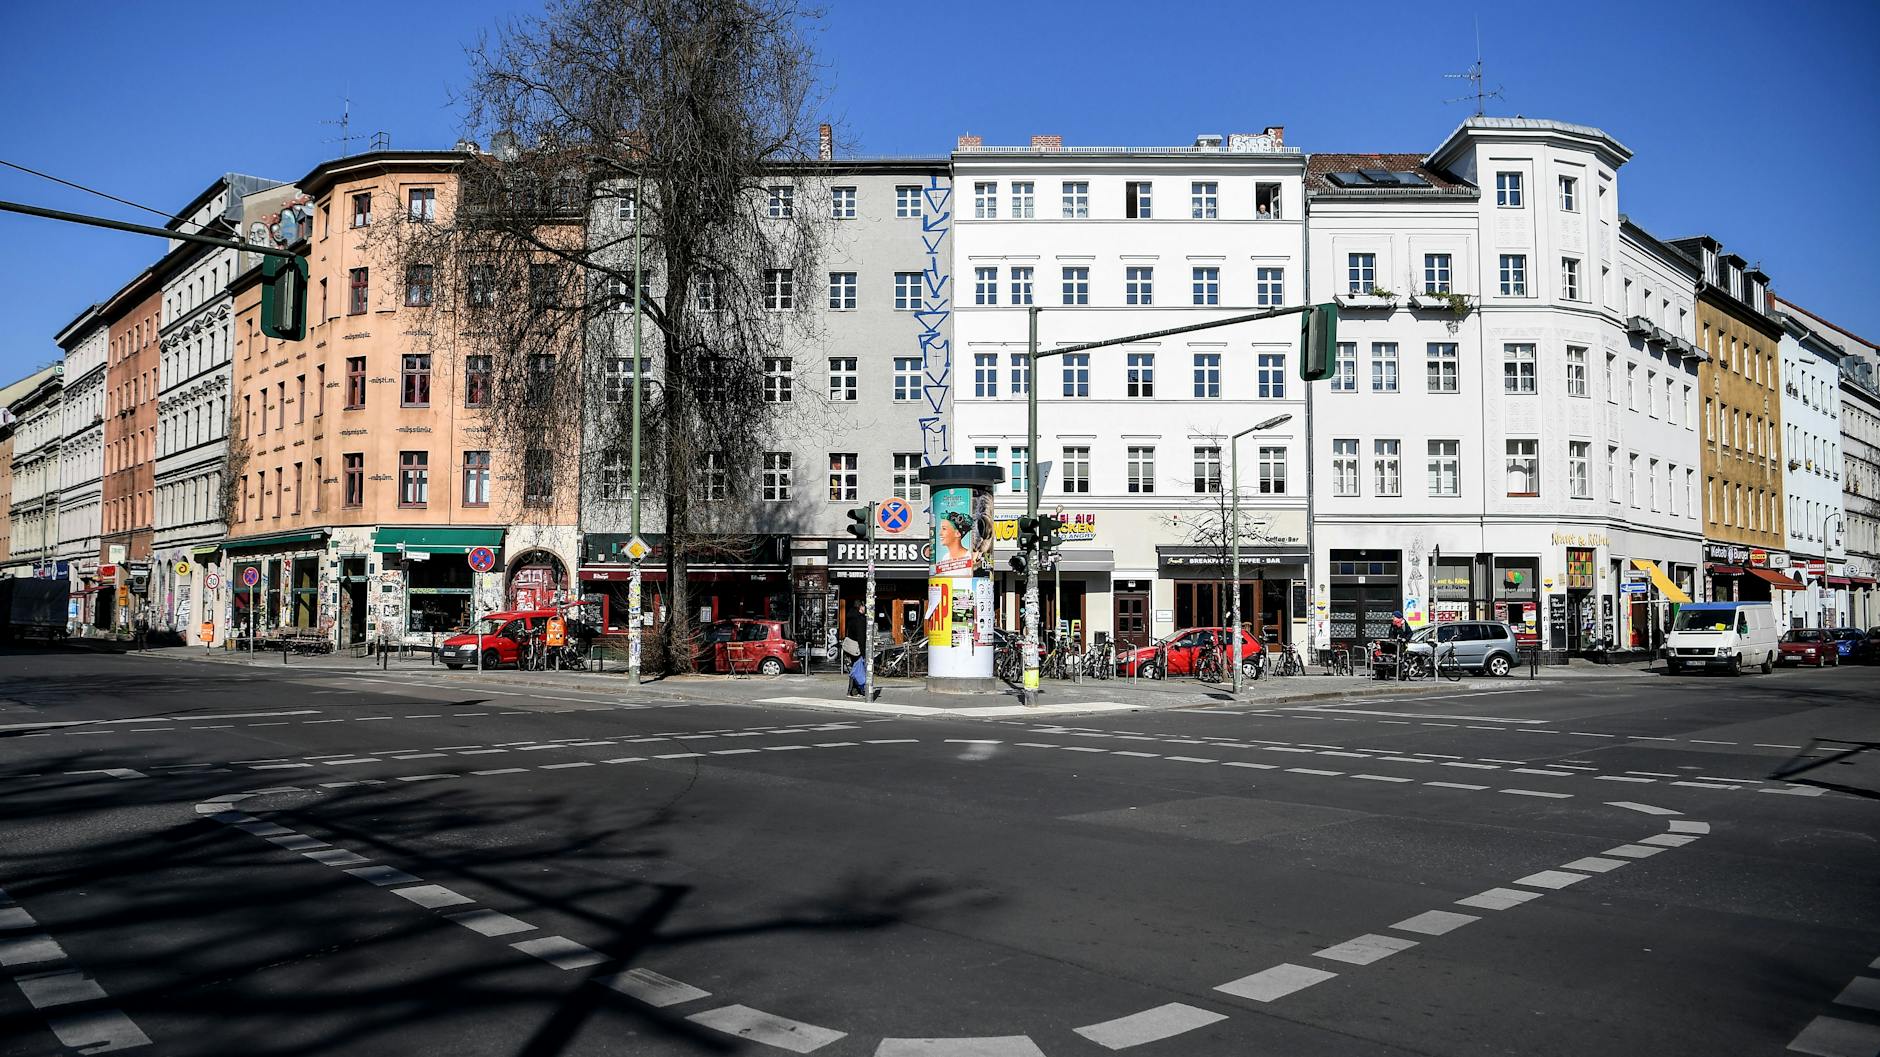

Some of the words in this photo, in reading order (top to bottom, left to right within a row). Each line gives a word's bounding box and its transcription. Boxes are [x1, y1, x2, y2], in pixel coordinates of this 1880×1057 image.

[837, 543, 918, 560] PFEIFFERS
[1711, 546, 1727, 558] Kebab
[1734, 548, 1749, 560] Burger
